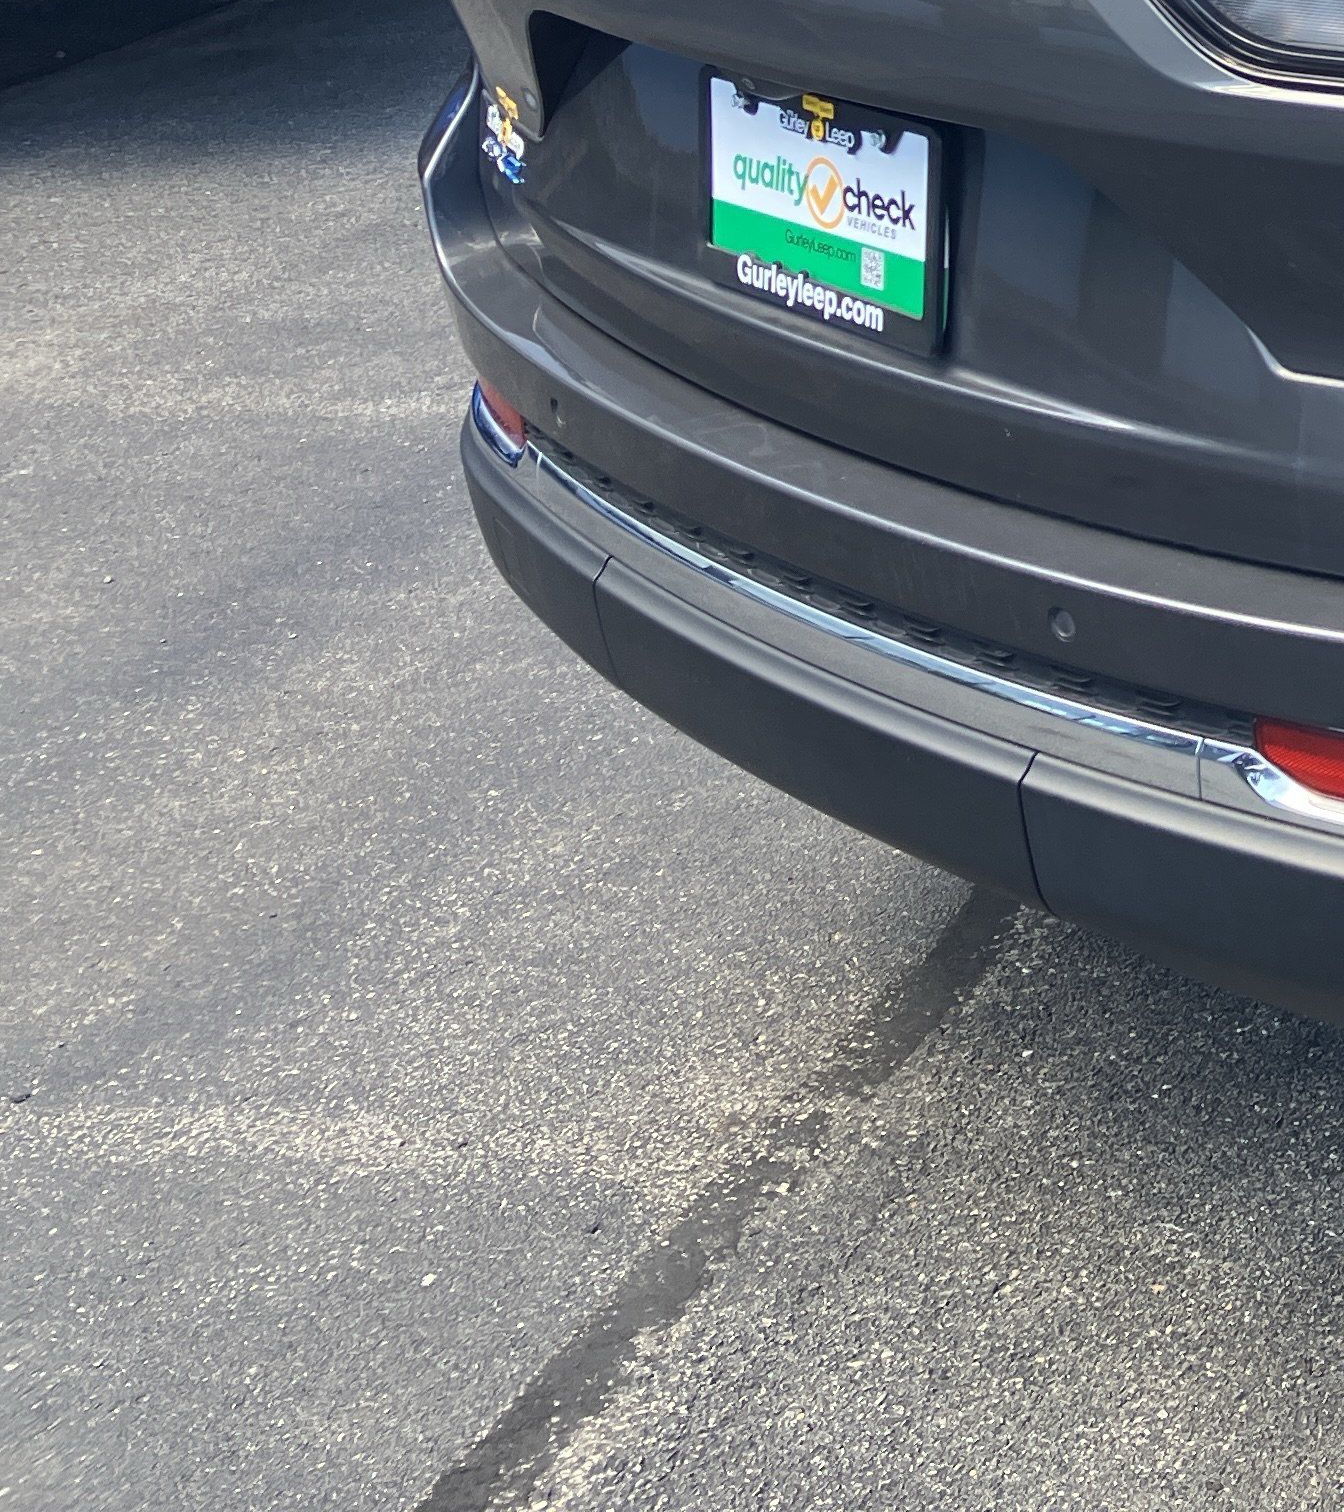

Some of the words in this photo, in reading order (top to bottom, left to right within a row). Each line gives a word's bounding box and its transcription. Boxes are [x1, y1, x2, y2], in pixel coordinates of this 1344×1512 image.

[825, 122, 857, 151] Leep
[733, 153, 809, 206] quality
[842, 178, 916, 230] check
[845, 216, 897, 240] VEHICLES
[737, 254, 884, 332] Gurleyleep.com
